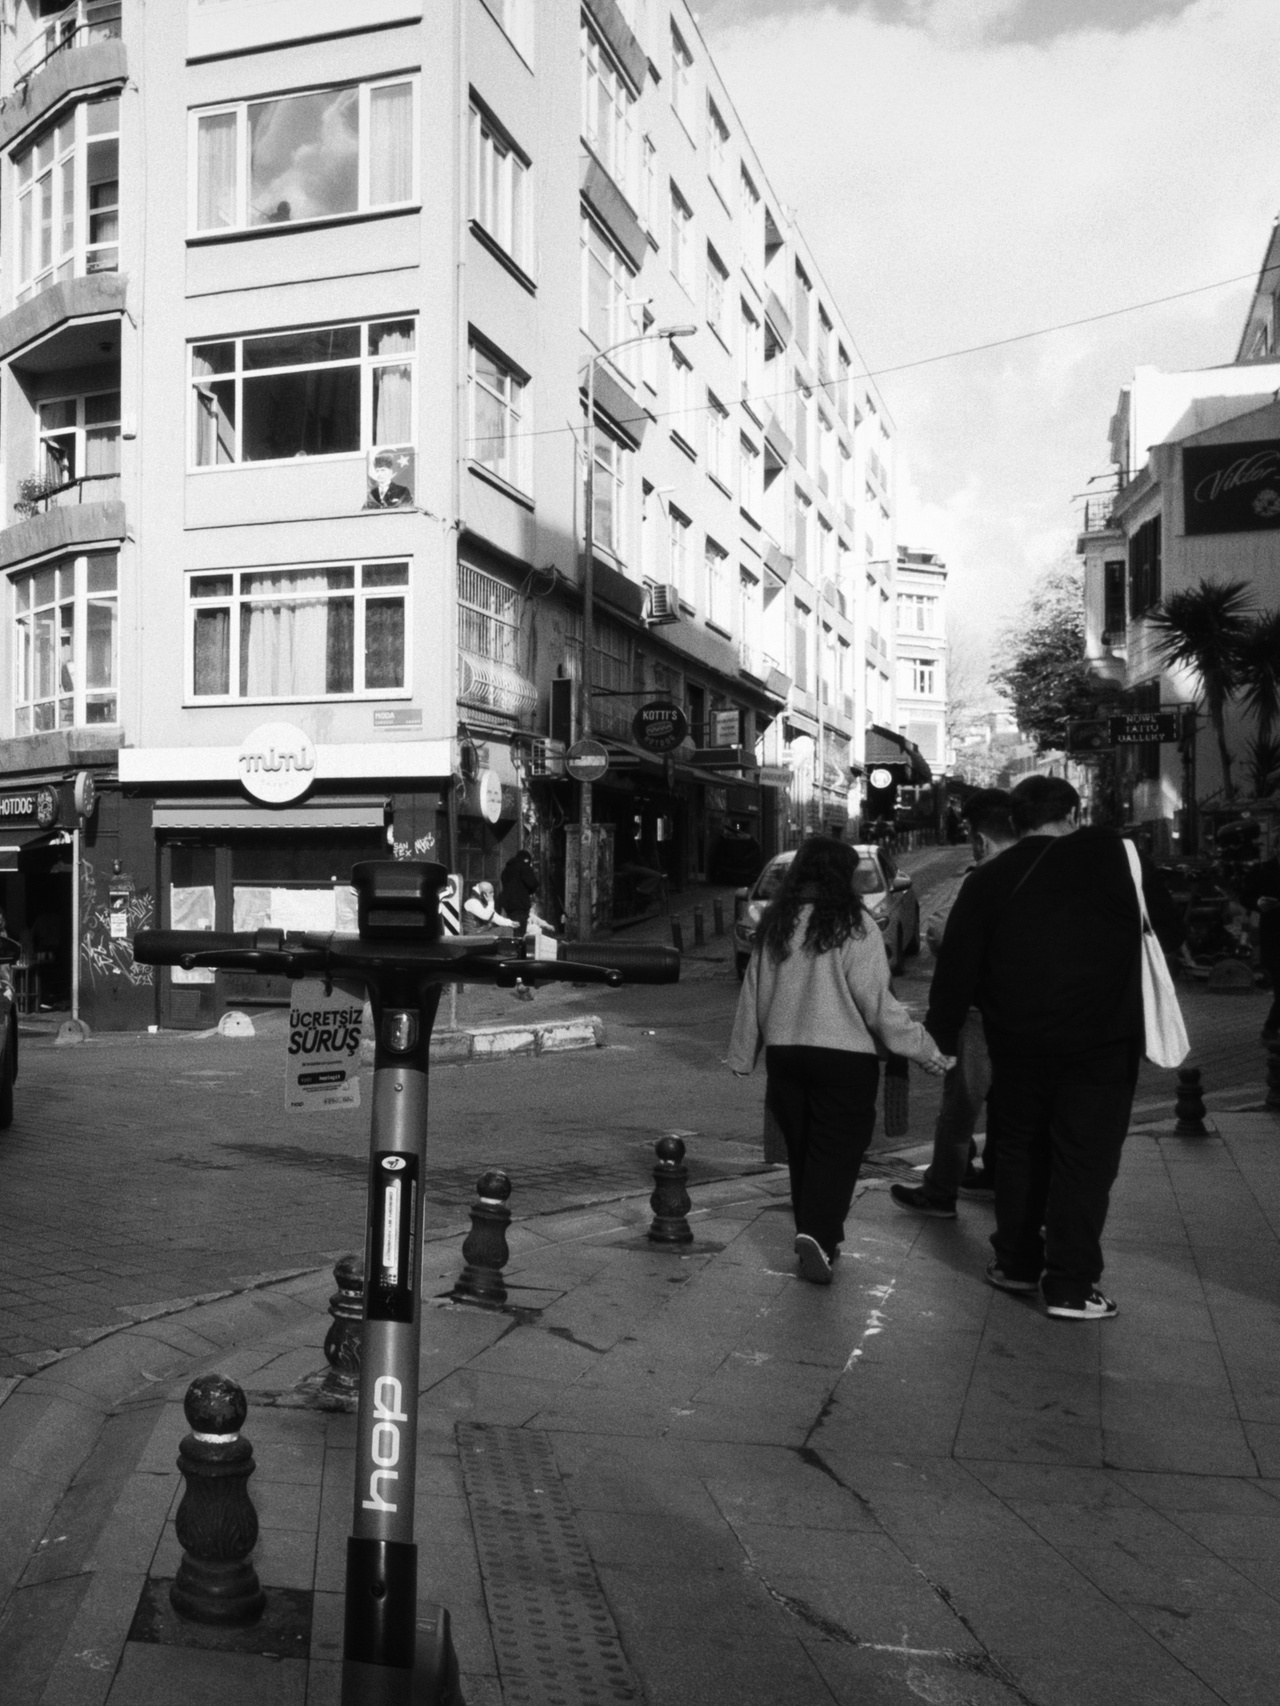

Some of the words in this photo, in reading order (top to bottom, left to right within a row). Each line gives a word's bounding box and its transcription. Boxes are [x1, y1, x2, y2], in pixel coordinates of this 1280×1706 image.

[374, 711, 395, 720] MODA
[642, 710, 678, 721] KOTTI'S
[239, 747, 314, 773] mini
[288, 1025, 361, 1057] SÜRÜŞ
[361, 1375, 408, 1513] hop
